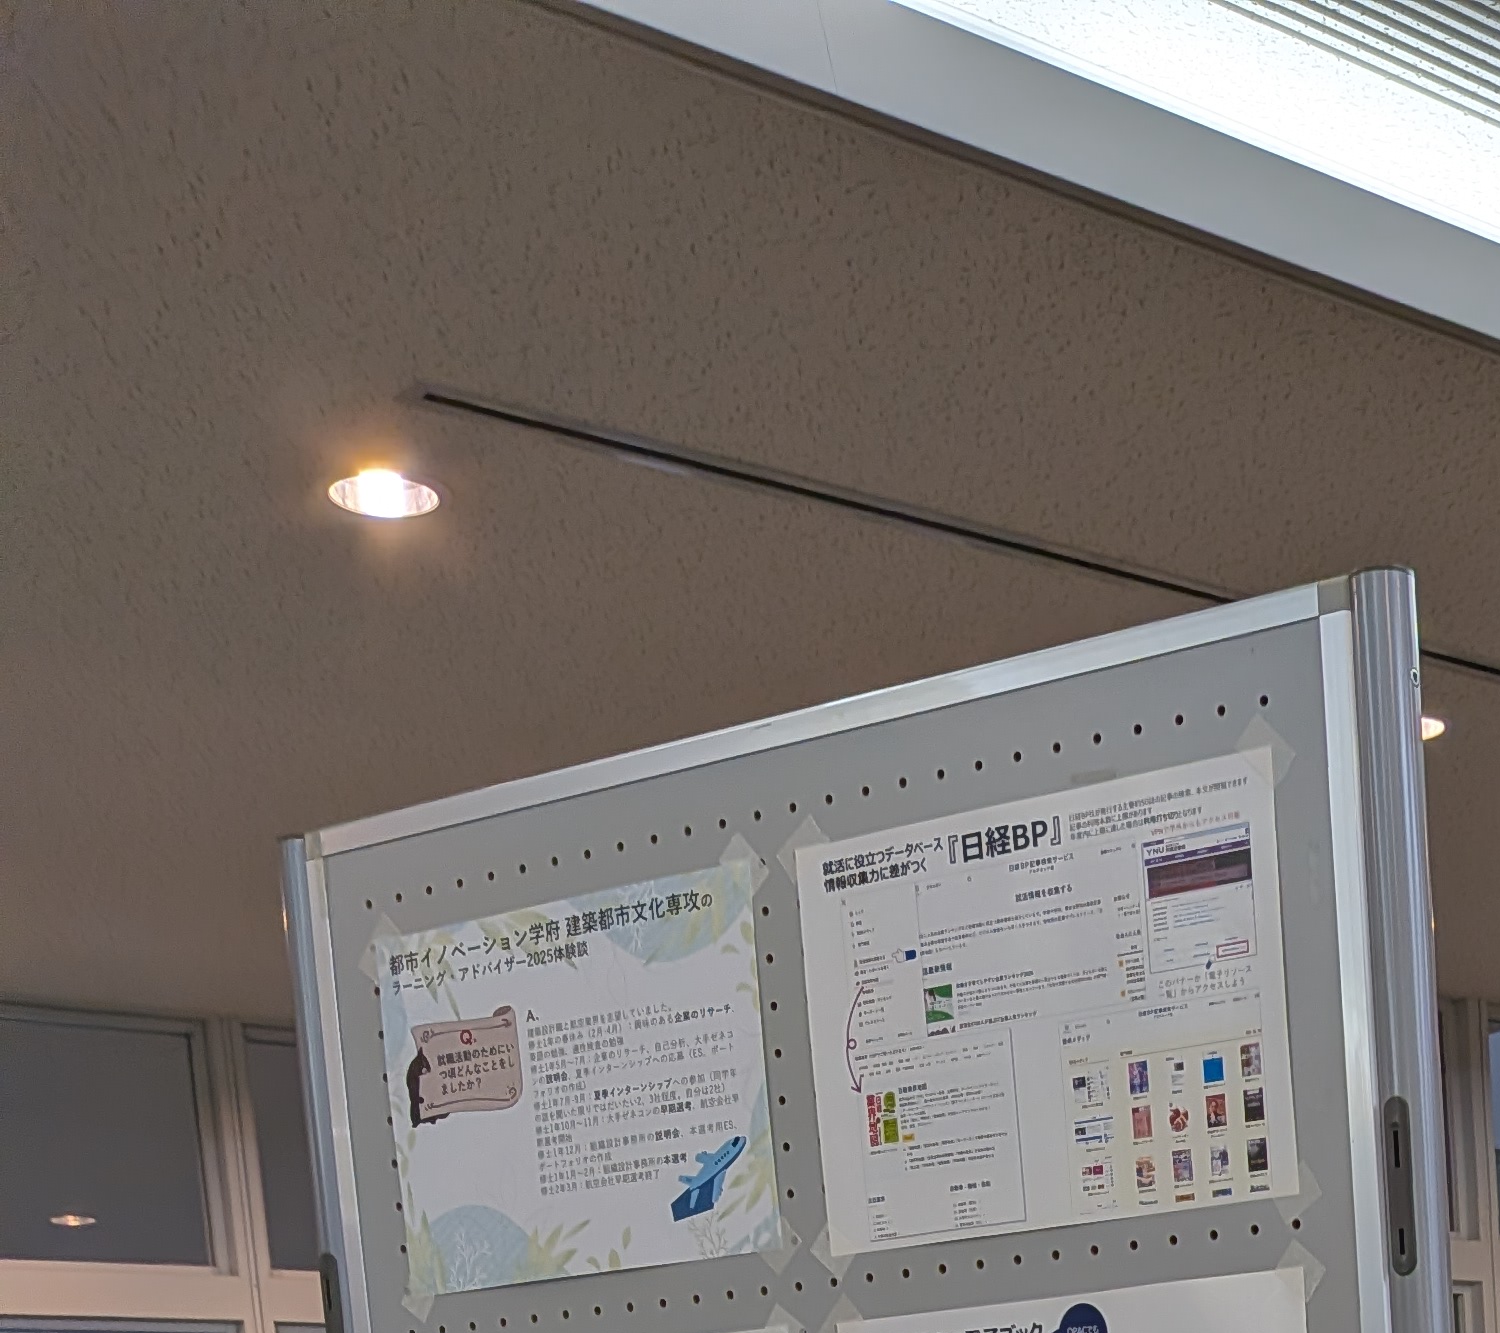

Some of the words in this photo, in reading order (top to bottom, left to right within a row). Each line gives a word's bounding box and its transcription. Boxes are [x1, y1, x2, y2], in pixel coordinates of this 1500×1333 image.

[822, 837, 943, 876] 就活に役立つデータベース
[947, 816, 1062, 864] 『日経BP』
[824, 858, 927, 893] 情報収集力に差がつく
[390, 920, 560, 976] 都市イノベーション学府
[566, 889, 713, 936] 建築都市文化専攻の
[393, 940, 589, 995] ラーニング・アドバイザー2025体験談
